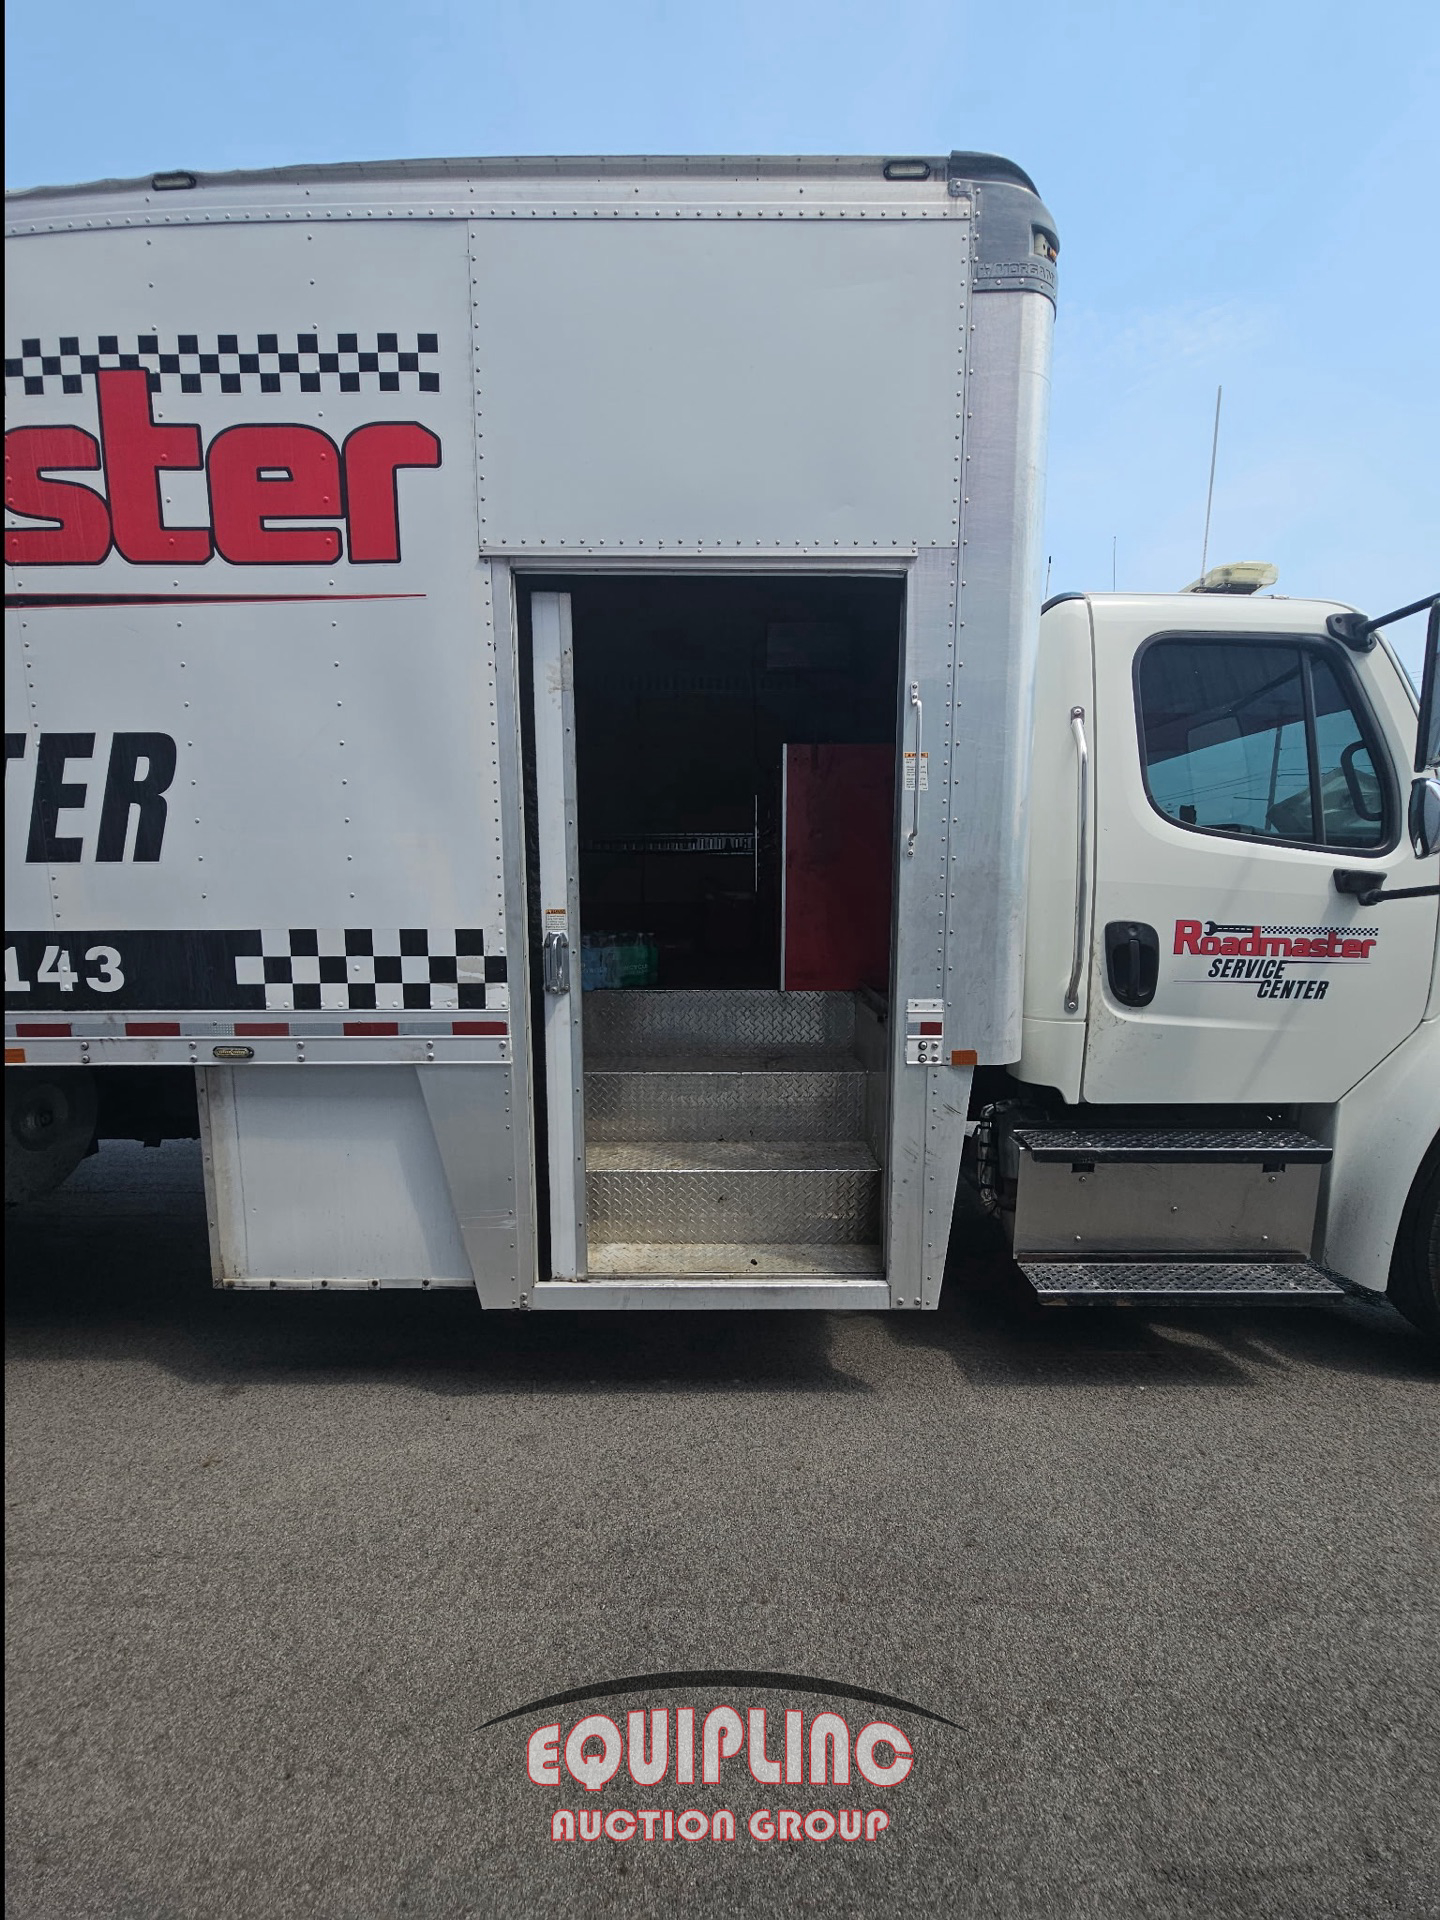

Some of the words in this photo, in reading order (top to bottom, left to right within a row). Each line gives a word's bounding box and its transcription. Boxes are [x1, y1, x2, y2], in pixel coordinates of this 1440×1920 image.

[994, 262, 1055, 283] MORGAN
[5, 367, 441, 566] ster
[1173, 920, 1377, 959] Roadmaster
[5, 945, 125, 993] 143
[1208, 958, 1288, 979] SERVICE
[1257, 979, 1329, 1000] CENTER
